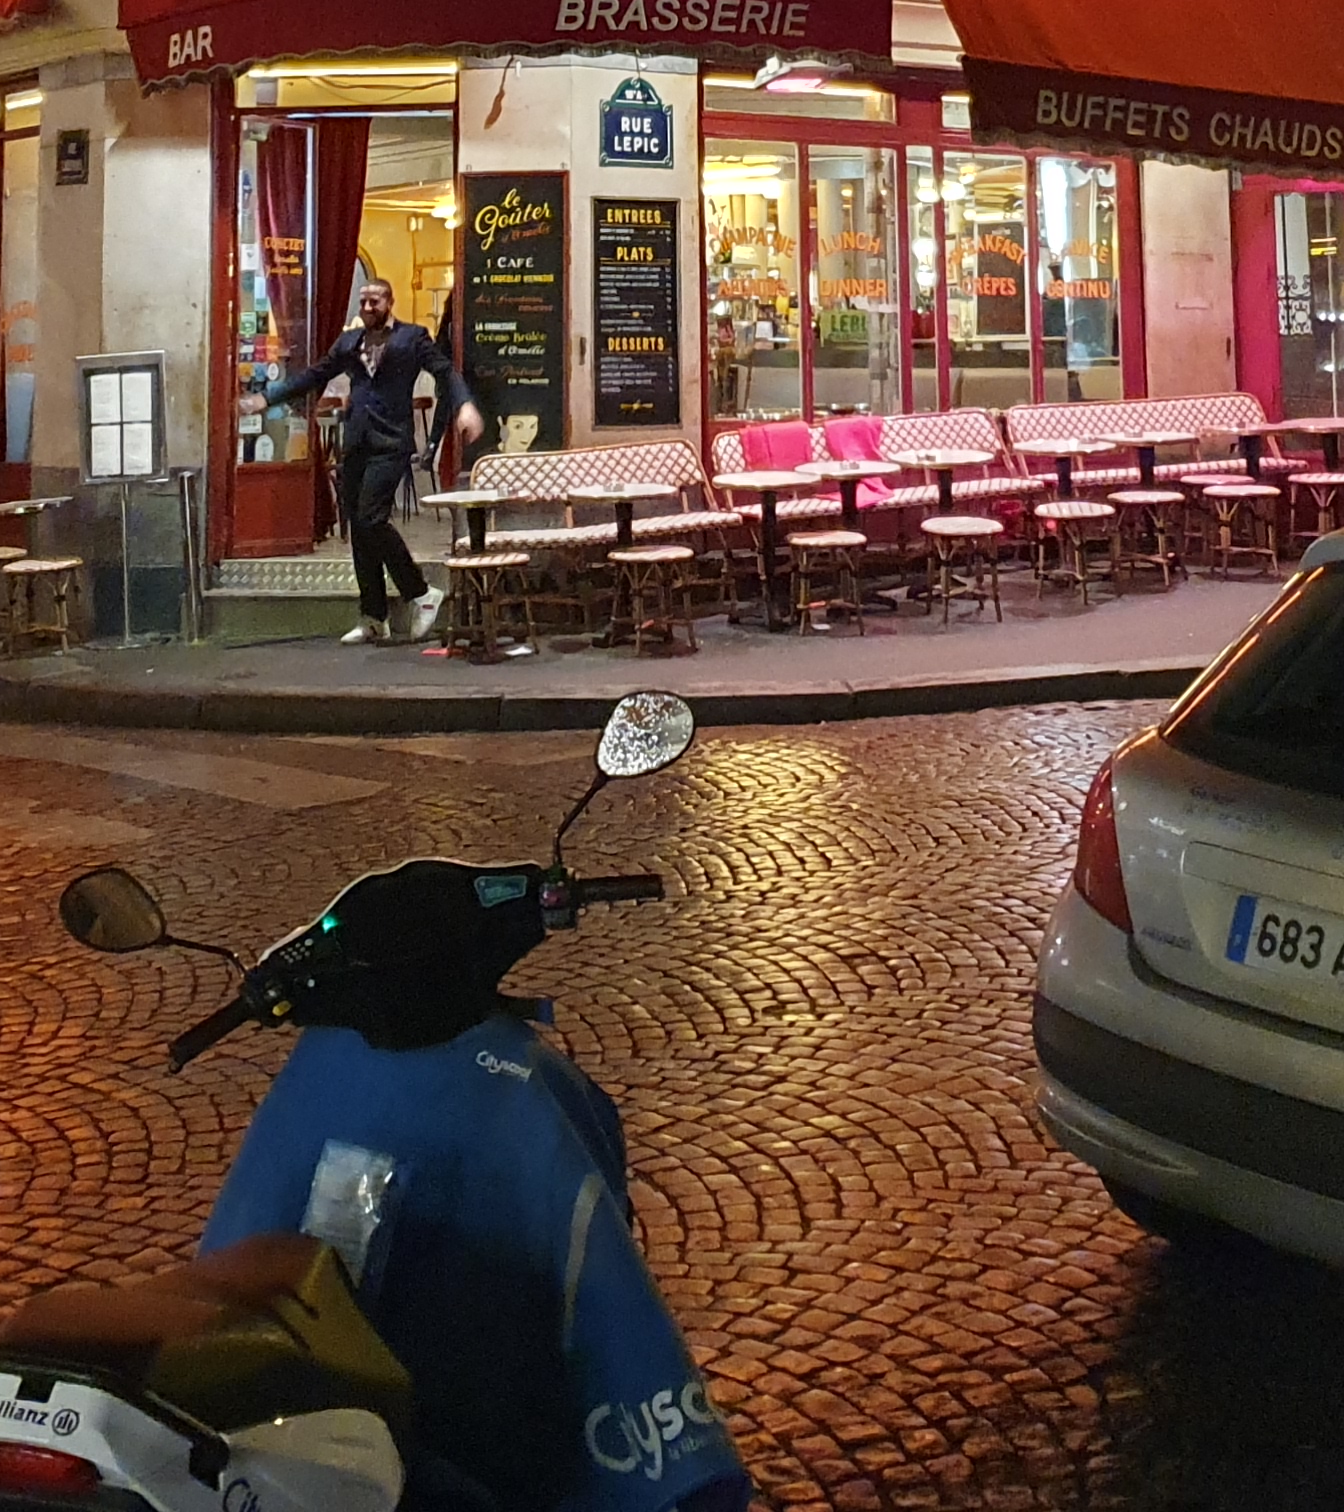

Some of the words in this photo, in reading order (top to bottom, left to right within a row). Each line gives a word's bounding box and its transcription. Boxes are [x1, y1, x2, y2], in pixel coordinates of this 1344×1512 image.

[167, 25, 213, 68] BAR
[621, 116, 652, 134] RUE
[1036, 89, 1190, 142] BUFFETS
[1209, 112, 1343, 161] CHAUDS
[614, 136, 659, 154] LEPIC
[501, 188, 520, 209] le
[709, 226, 796, 259] CHAMPANE
[820, 231, 882, 258] LUNCH
[616, 246, 654, 261] PLATS
[819, 278, 887, 298] DINNER
[1046, 279, 1111, 299] CONTINU
[607, 336, 665, 352] DESSERTS
[1257, 914, 1325, 969] 683
